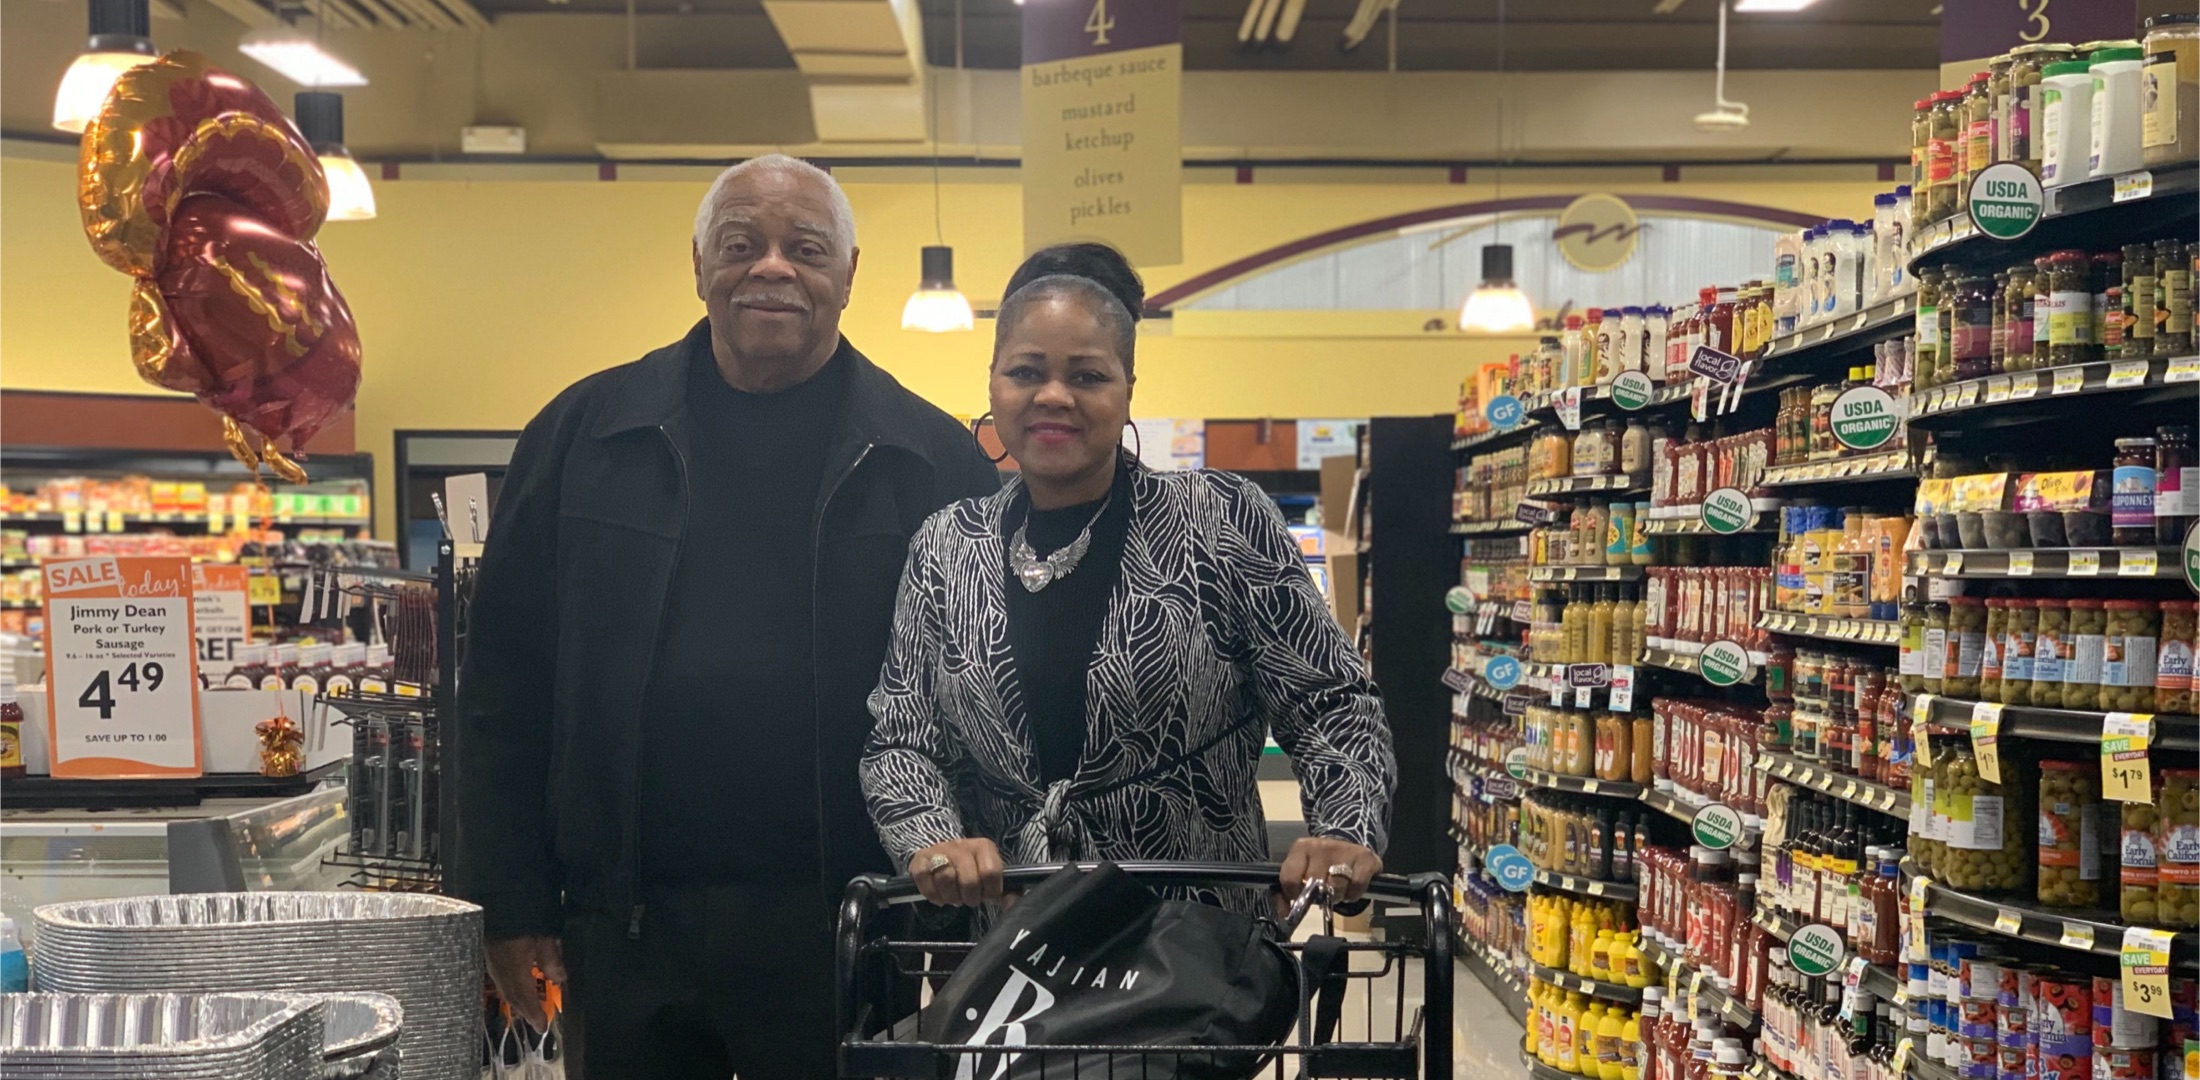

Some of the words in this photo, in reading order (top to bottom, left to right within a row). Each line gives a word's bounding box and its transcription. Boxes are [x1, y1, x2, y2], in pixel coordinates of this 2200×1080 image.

[1084, 0, 1115, 45] 4
[2018, 0, 2050, 42] 3
[1032, 64, 1113, 87] barbeque
[1118, 57, 1167, 76] sauce
[1061, 95, 1136, 121] mustard
[1065, 128, 1135, 151] ketchup
[1074, 169, 1124, 188] olives
[1986, 180, 2028, 199] USDA
[1070, 198, 1131, 225] pickles
[1979, 204, 2032, 220] ORGANIC
[1694, 359, 1718, 373] flavor
[1698, 350, 1722, 366] local
[1622, 377, 1646, 391] USDA
[1615, 387, 1646, 403] ORGANIC
[1493, 403, 1515, 420] GF
[1843, 399, 1884, 417] USDA
[1841, 418, 1891, 435] ORGANIC
[1716, 494, 1743, 514] USDA
[1706, 506, 1741, 527] ORGANIC
[50, 562, 116, 588] SALE
[118, 564, 187, 598] today!
[70, 605, 119, 621] Jimmy
[125, 604, 167, 617] Dean
[73, 623, 102, 634] Pork
[106, 626, 119, 634] or
[122, 623, 165, 635] Turkey
[96, 639, 145, 651] Sausage
[144, 651, 176, 659] Varieties
[1713, 647, 1740, 667] USDA
[2163, 655, 2188, 666] Early
[1492, 662, 1514, 680] GF
[1574, 668, 1592, 676] local
[1703, 658, 1738, 679] ORGANIC
[85, 734, 111, 743] SAVE
[113, 734, 128, 742] UP
[130, 734, 145, 742] TO
[148, 733, 167, 742] 1.00
[2103, 739, 2129, 753] SAVE
[2114, 751, 2145, 761] EVERYDAY
[1706, 811, 1733, 830] USDA
[1697, 822, 1731, 843] ORGANIC
[2125, 846, 2148, 856] Early
[1503, 864, 1528, 879] GF
[1804, 931, 1835, 955] USDA
[1009, 928, 1140, 990] YAJIAN
[1793, 944, 1832, 969] ORGANIC
[2123, 953, 2150, 965] SAVE
